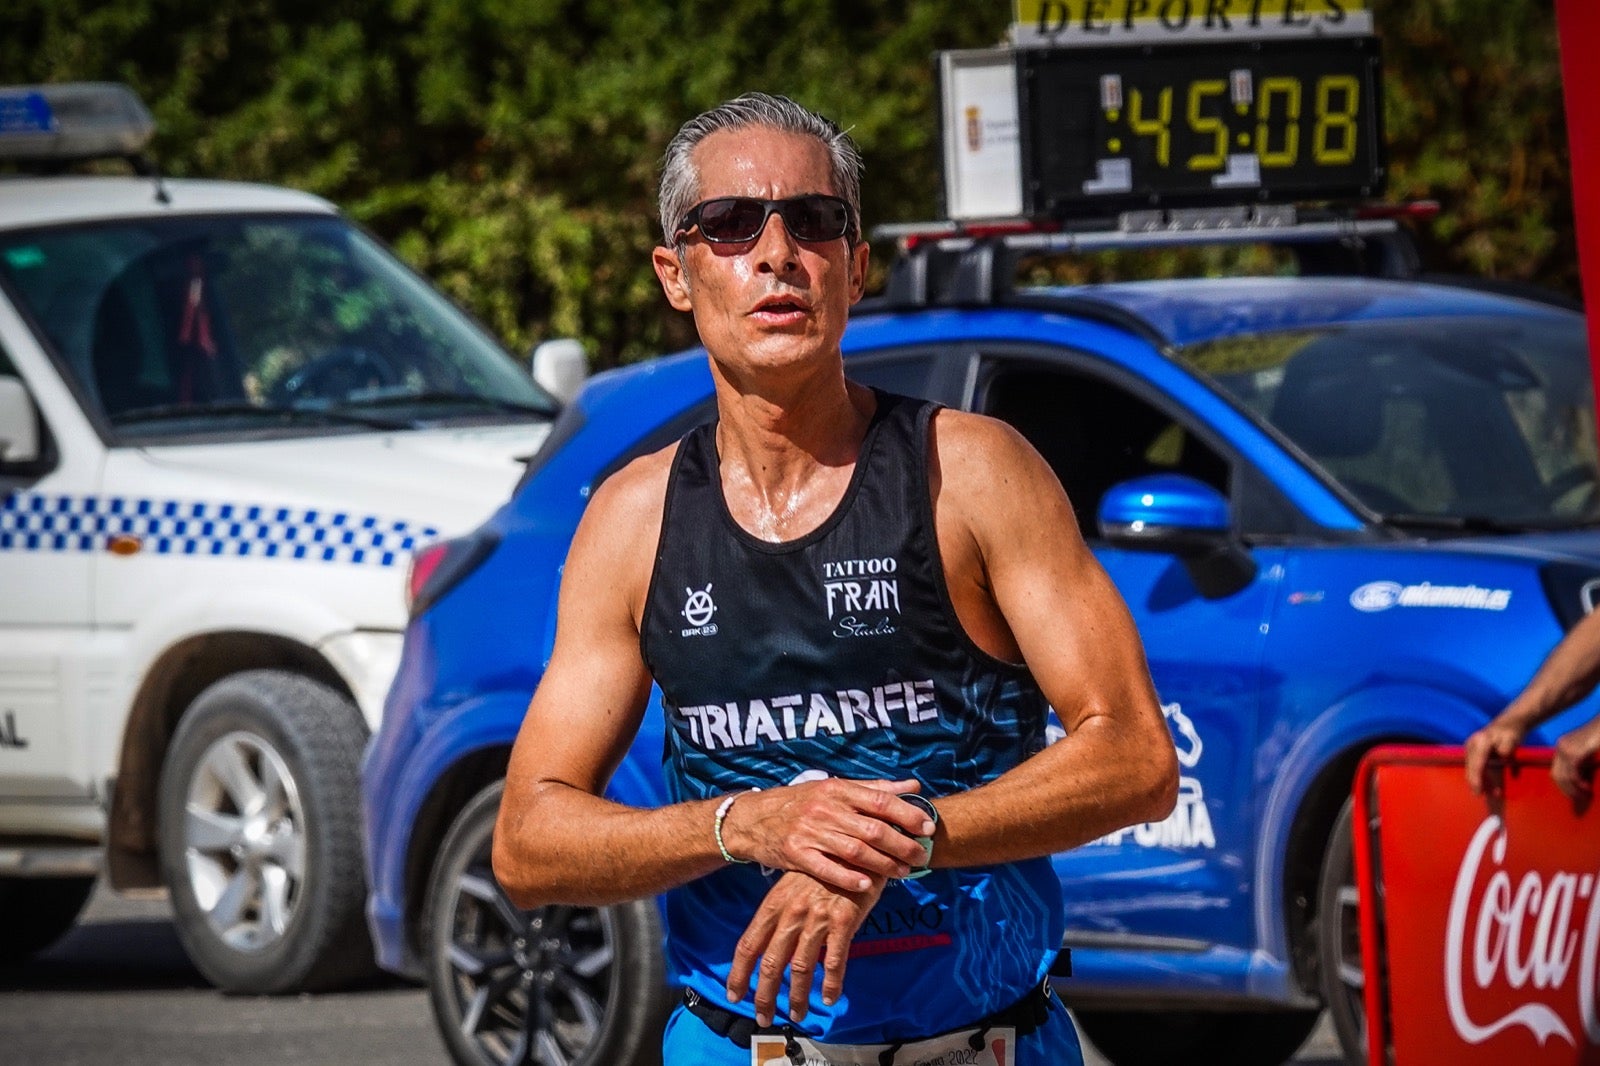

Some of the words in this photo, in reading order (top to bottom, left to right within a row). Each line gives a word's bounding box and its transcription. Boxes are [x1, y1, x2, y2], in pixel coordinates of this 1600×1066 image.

[1035, 0, 1347, 37] DEPORTES
[823, 557, 897, 578] TATTOO
[823, 580, 902, 621] FRAN
[832, 615, 897, 639] Studio
[678, 678, 939, 751] TRIATARFE
